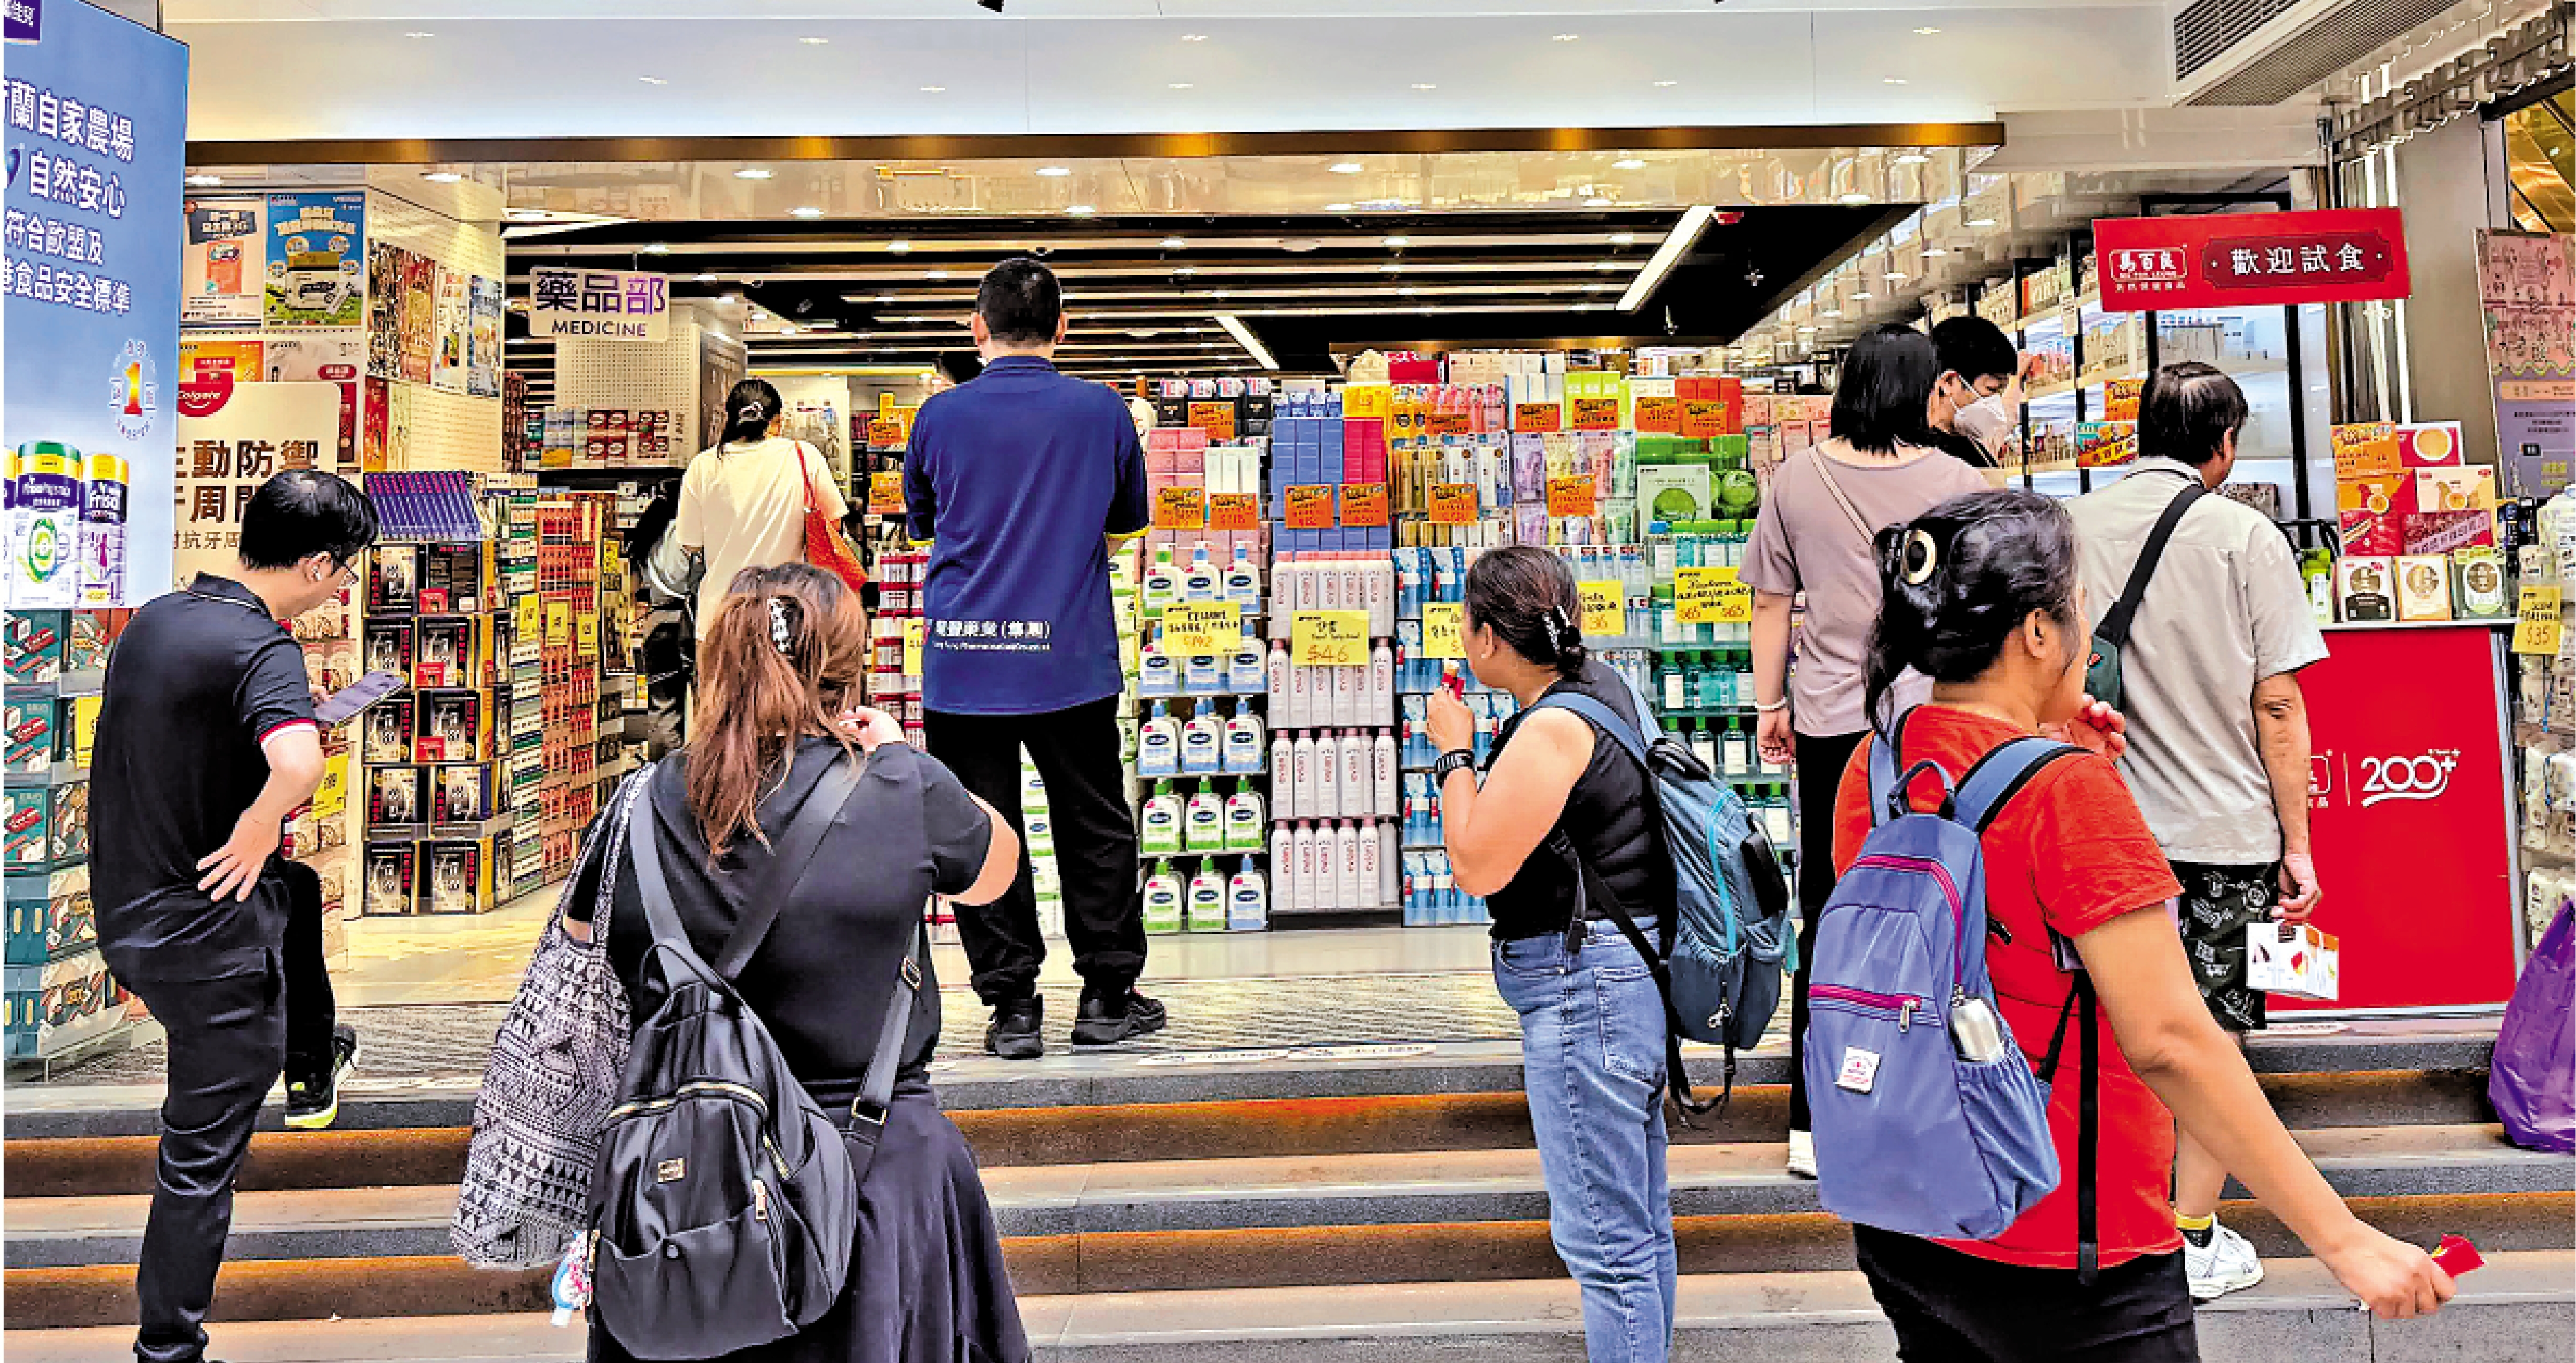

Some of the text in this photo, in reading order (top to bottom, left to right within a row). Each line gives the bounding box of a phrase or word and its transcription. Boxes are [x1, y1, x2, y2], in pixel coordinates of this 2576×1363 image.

[4, 78, 134, 161] 蘭自家農場
[29, 150, 126, 218] 自然安心
[4, 209, 103, 265] 符合歐盟及
[2230, 242, 2365, 276] 歡迎試食
[535, 271, 665, 315] 藥品部
[552, 318, 647, 337] MEDICINE
[1306, 644, 1349, 665] $46
